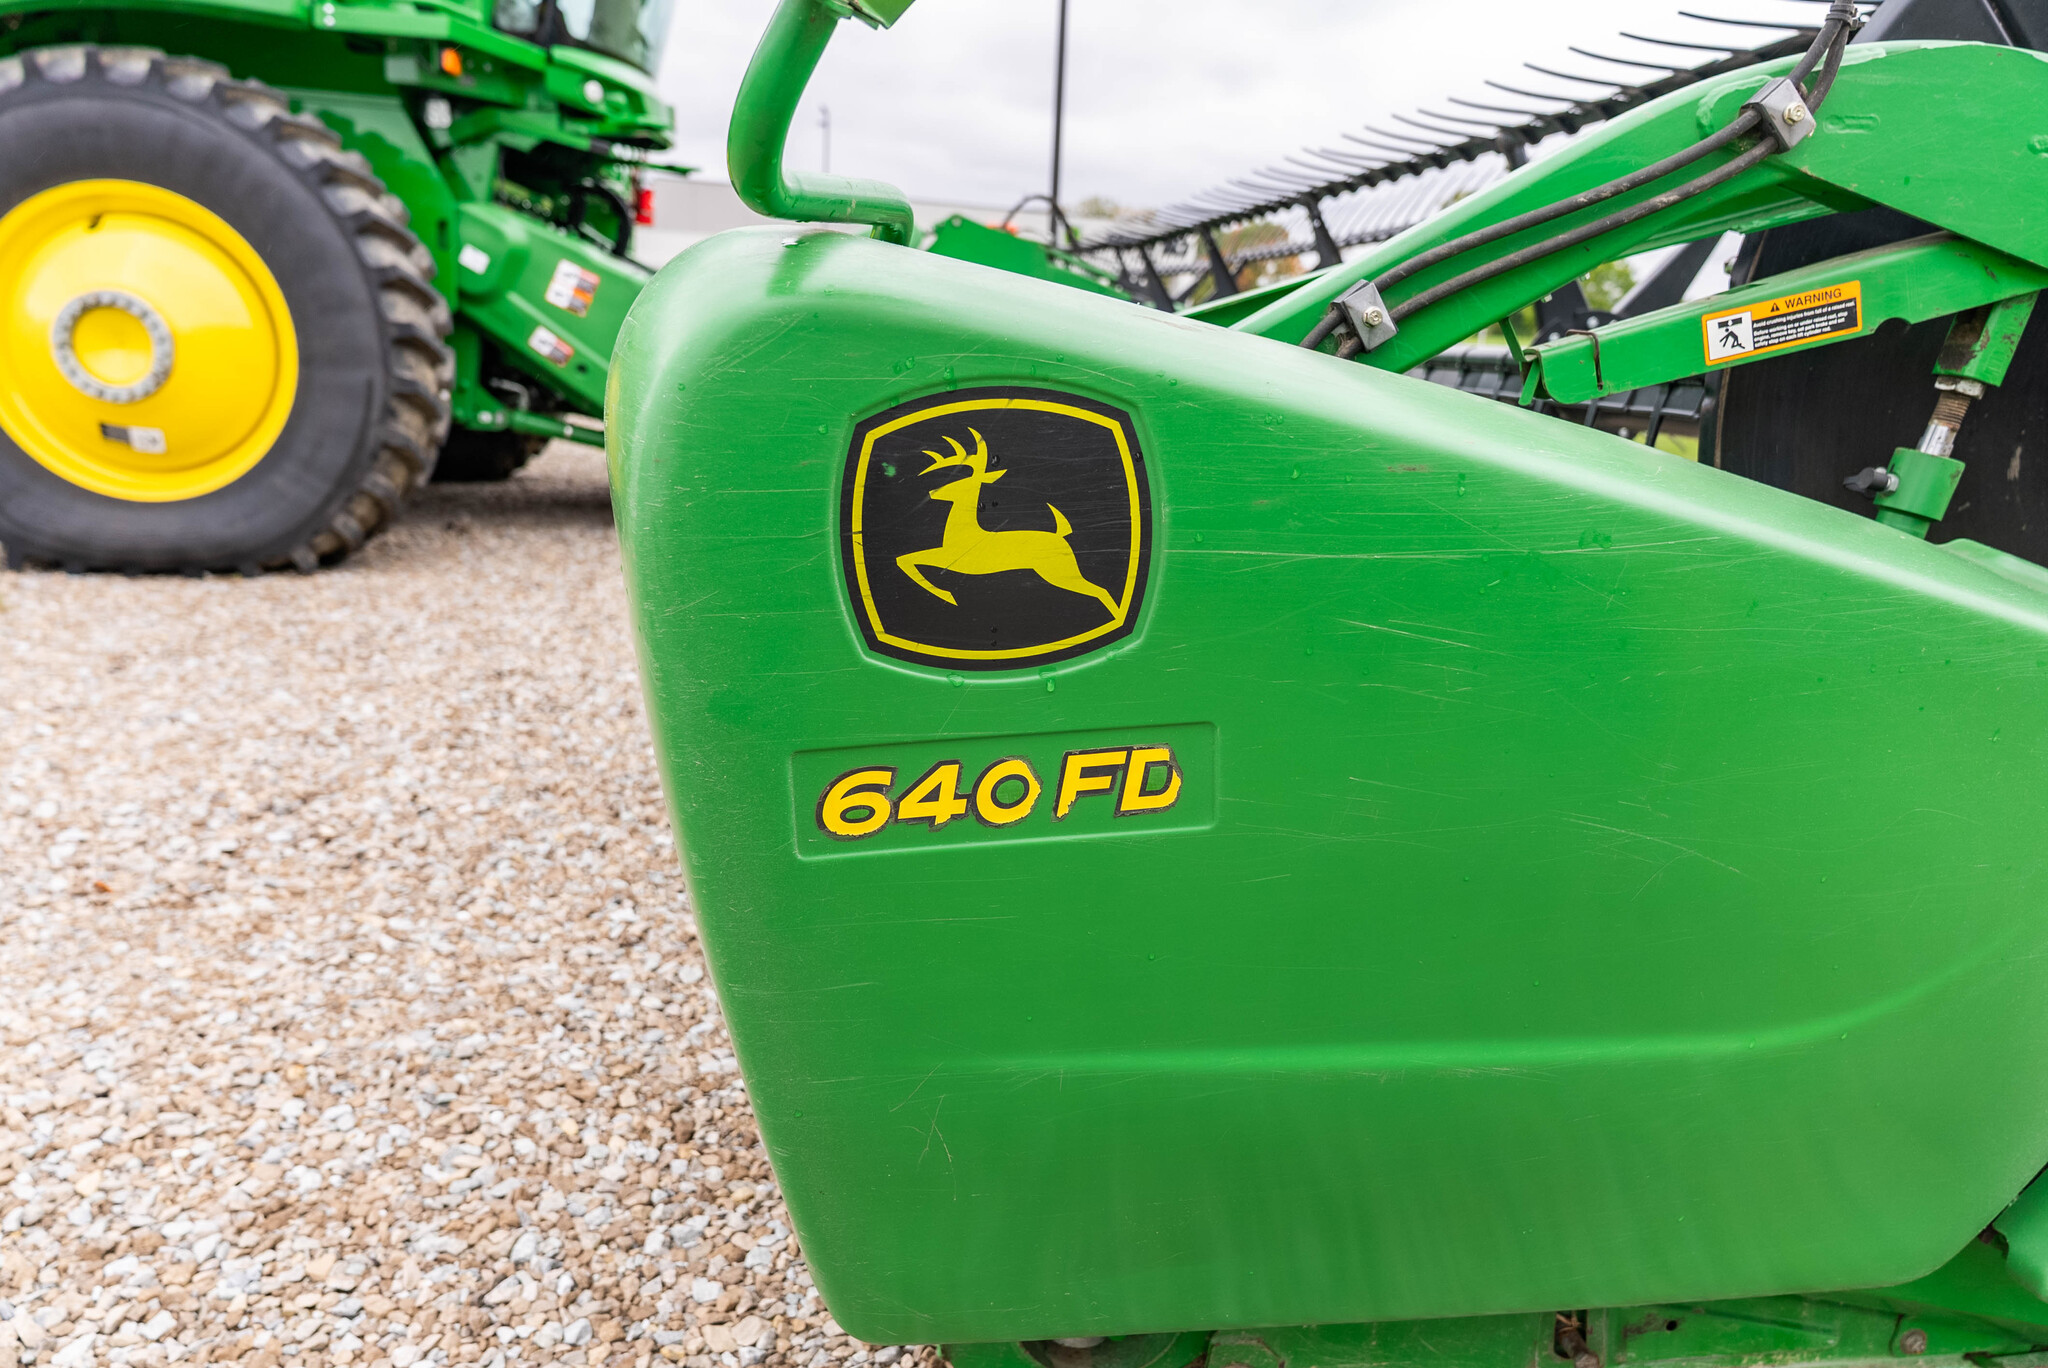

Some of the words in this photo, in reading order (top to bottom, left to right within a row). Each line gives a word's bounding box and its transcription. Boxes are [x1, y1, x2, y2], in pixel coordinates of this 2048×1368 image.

[1785, 288, 1842, 309] WARNING
[816, 755, 1043, 842] 640
[1051, 743, 1184, 822] FD
